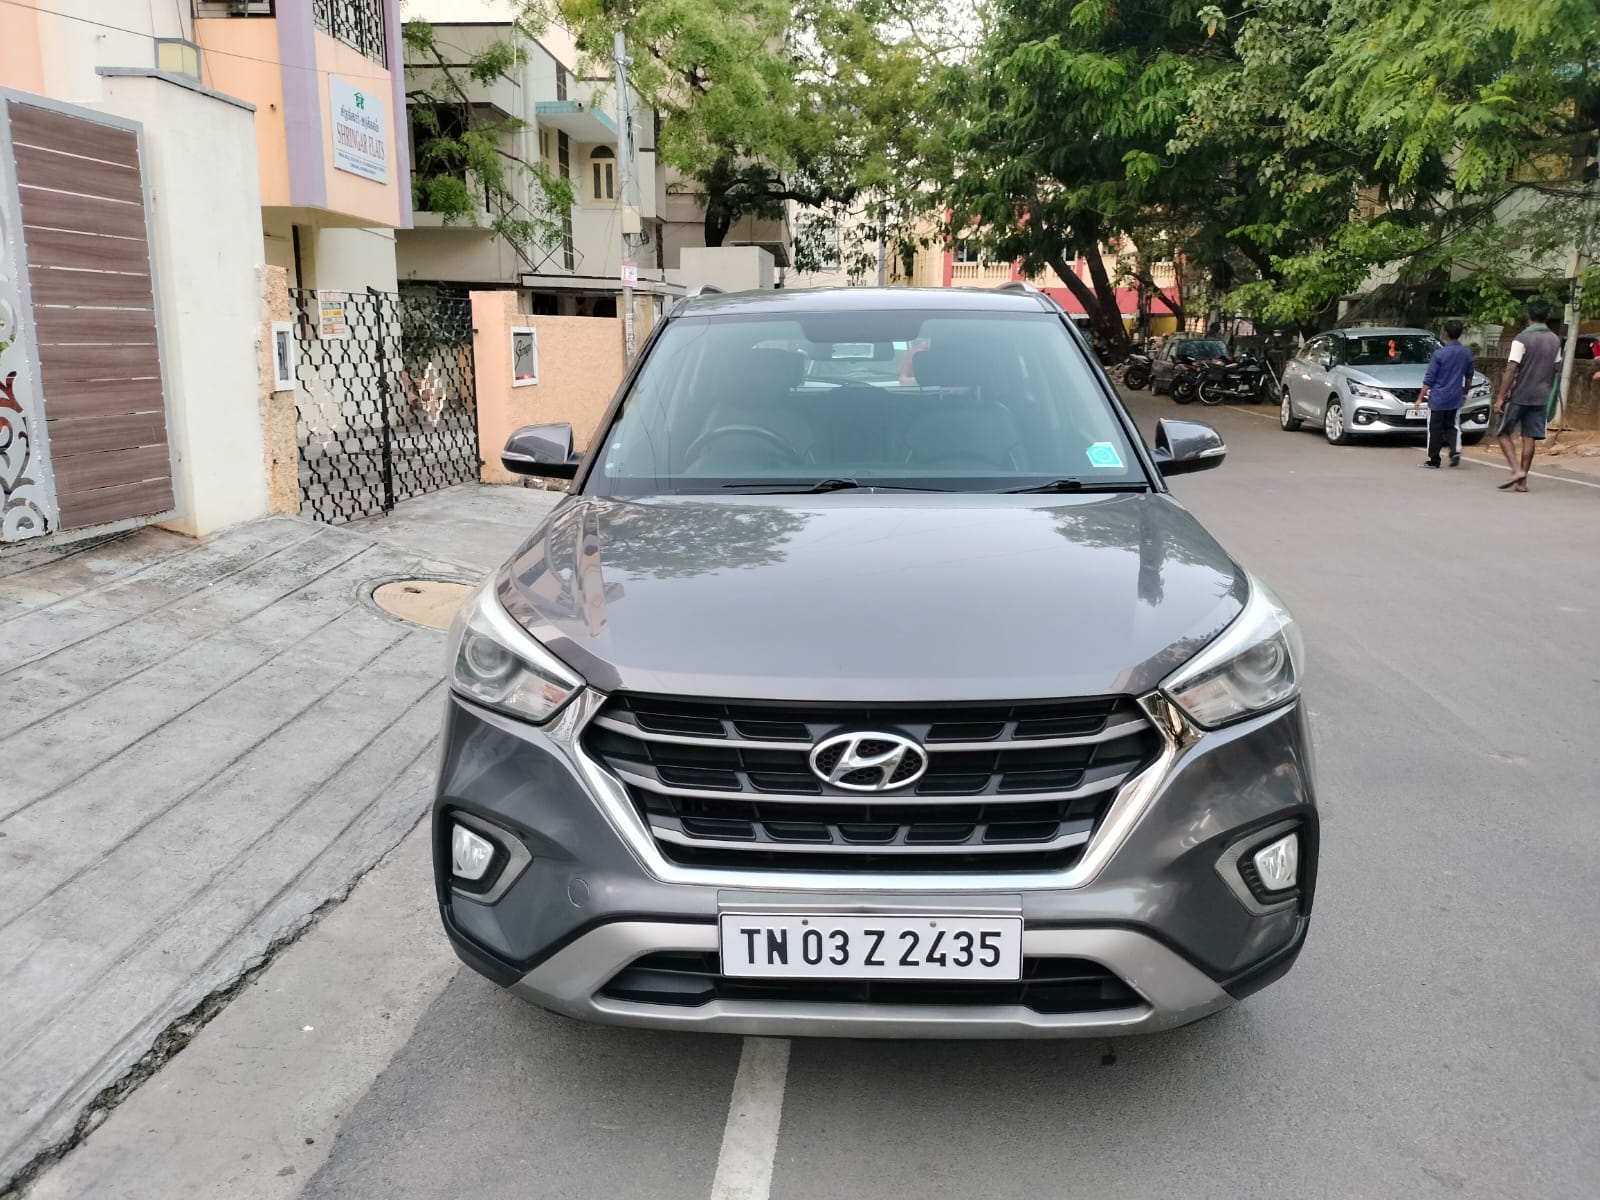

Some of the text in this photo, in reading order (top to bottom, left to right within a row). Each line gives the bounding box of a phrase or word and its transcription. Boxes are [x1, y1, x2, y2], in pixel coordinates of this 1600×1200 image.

[368, 135, 385, 160] FLATS
[740, 928, 1002, 967] TN 03 Z 2435
